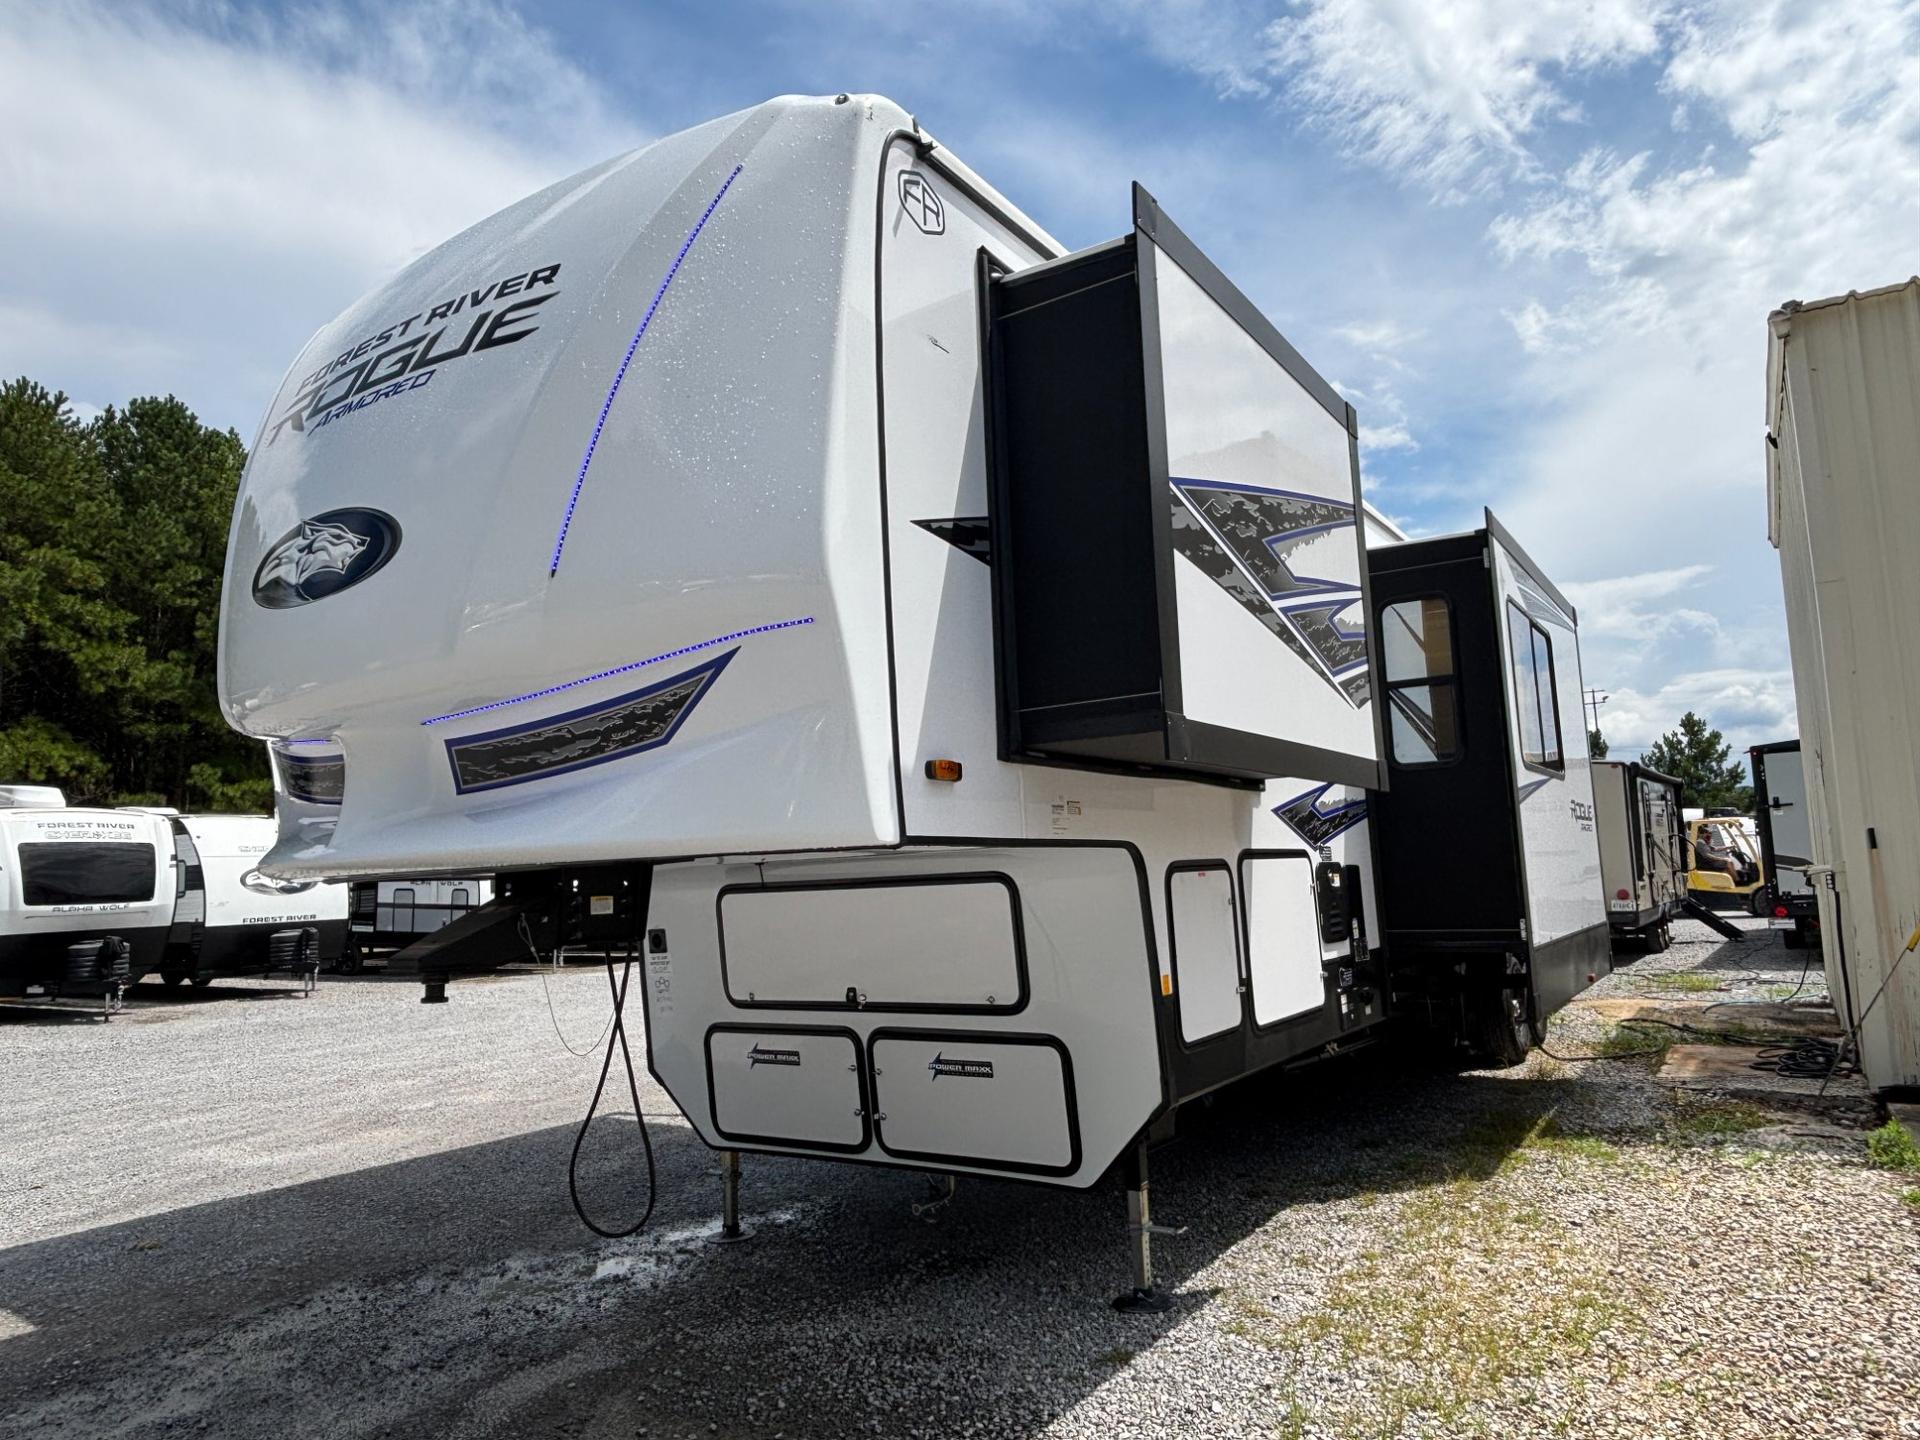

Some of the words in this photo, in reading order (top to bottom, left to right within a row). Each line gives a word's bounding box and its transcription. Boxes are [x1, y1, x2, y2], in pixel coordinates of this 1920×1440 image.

[295, 313, 422, 397] FOREST
[424, 263, 562, 326] RIVER
[267, 290, 561, 447] ROGUE
[307, 369, 437, 437] ARMORED
[96, 822, 135, 830] RIVER
[242, 916, 284, 924] FOREST
[929, 1063, 962, 1071] POWER
